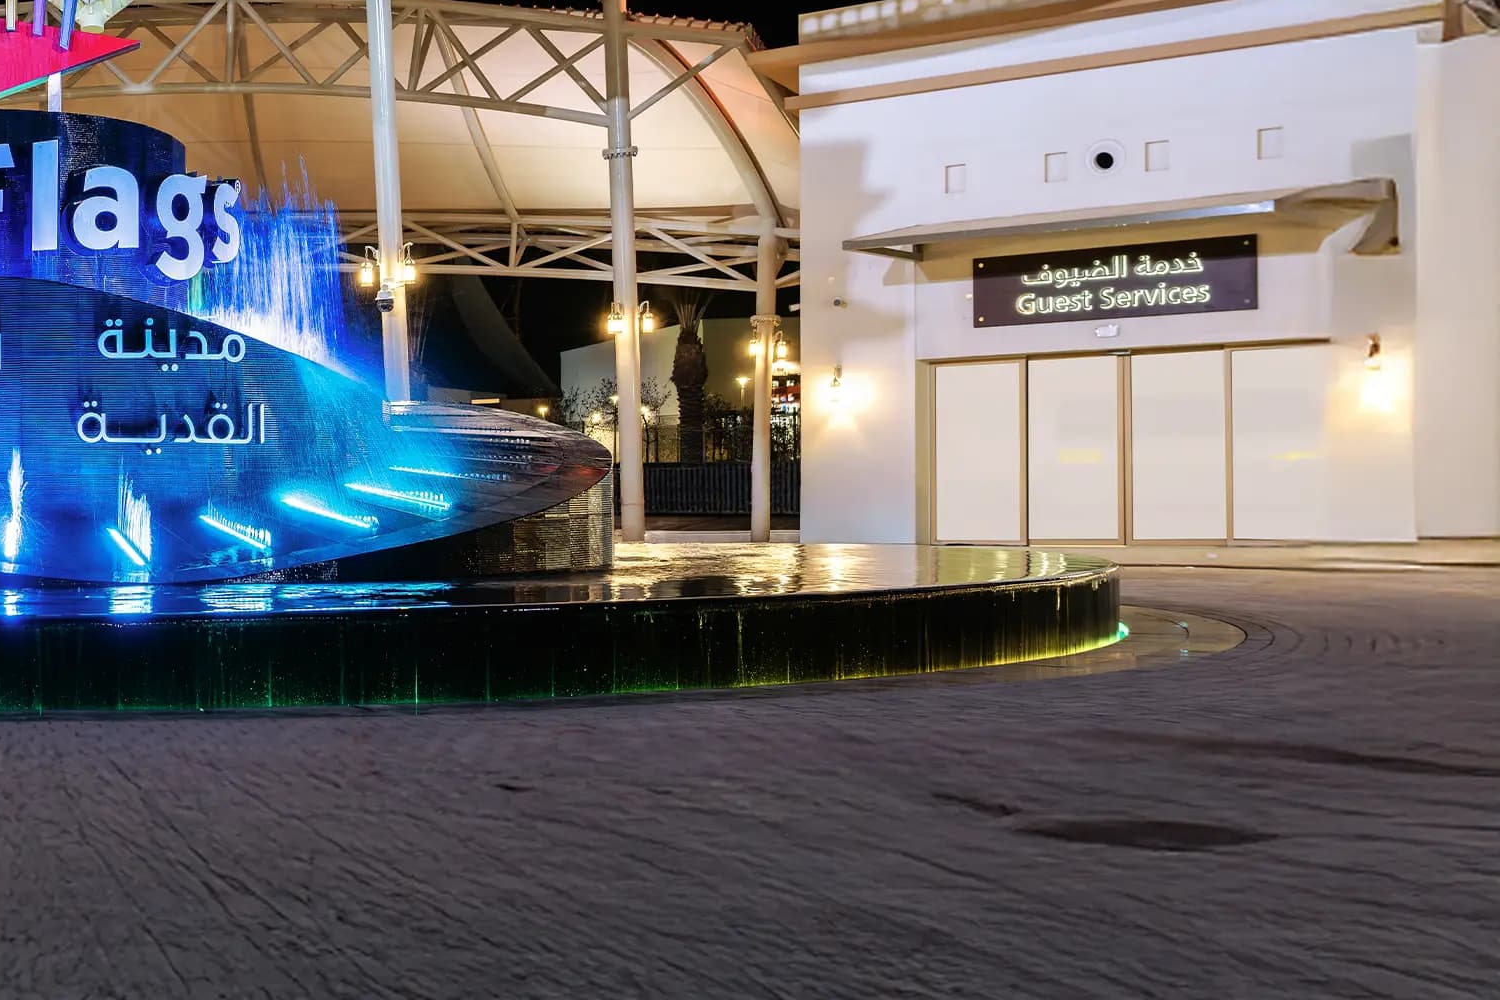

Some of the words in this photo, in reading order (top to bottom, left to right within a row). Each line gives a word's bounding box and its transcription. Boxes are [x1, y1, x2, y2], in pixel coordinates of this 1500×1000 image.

[1020, 254, 1127, 289] الضيوف
[1134, 251, 1204, 276] خدمة
[1015, 289, 1093, 316] Guest
[1100, 282, 1212, 309] Services
[97, 317, 246, 372] مدينة
[77, 400, 265, 455] القدية
